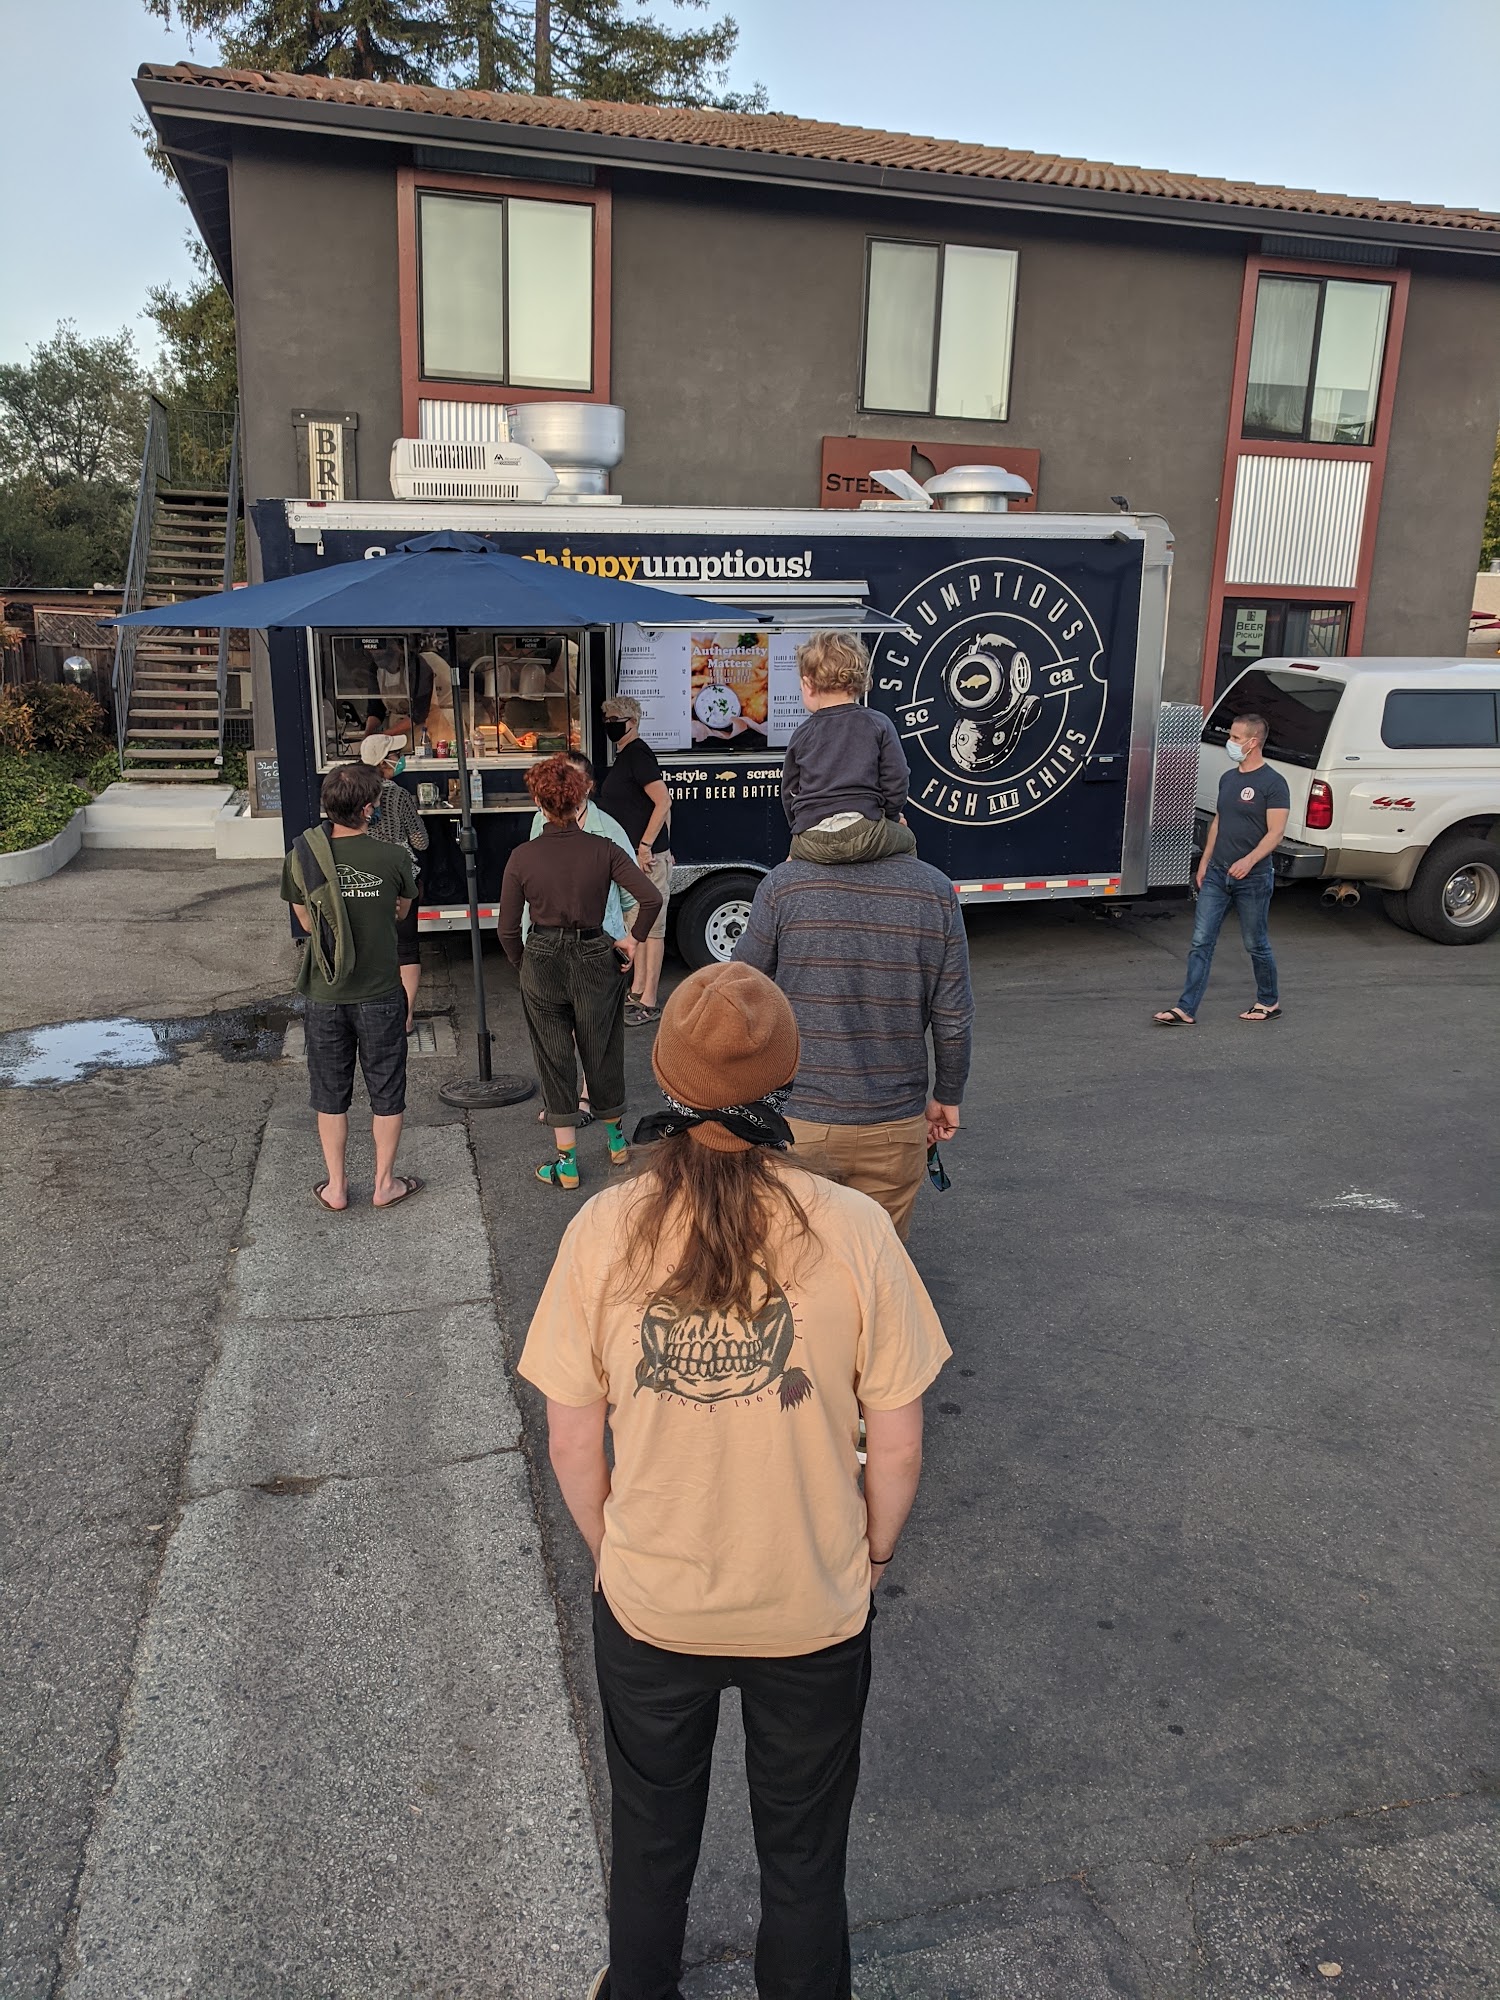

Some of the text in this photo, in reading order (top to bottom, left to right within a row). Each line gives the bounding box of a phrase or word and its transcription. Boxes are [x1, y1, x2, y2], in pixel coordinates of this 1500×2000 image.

[879, 571, 1084, 691] SCRUMPTIOUS
[1236, 621, 1264, 631] BEER
[1235, 631, 1263, 639] PICKUP
[692, 646, 768, 659] Authenticity
[707, 658, 753, 669] Matters
[1049, 668, 1075, 686] ca
[905, 708, 929, 727] sc
[660, 769, 708, 784] h-style
[921, 728, 1087, 816] FISH AND CHIPS
[668, 784, 780, 800] RAFT BEER BATTE
[357, 889, 380, 898] host
[657, 1387, 774, 1413] SINCE 1966
